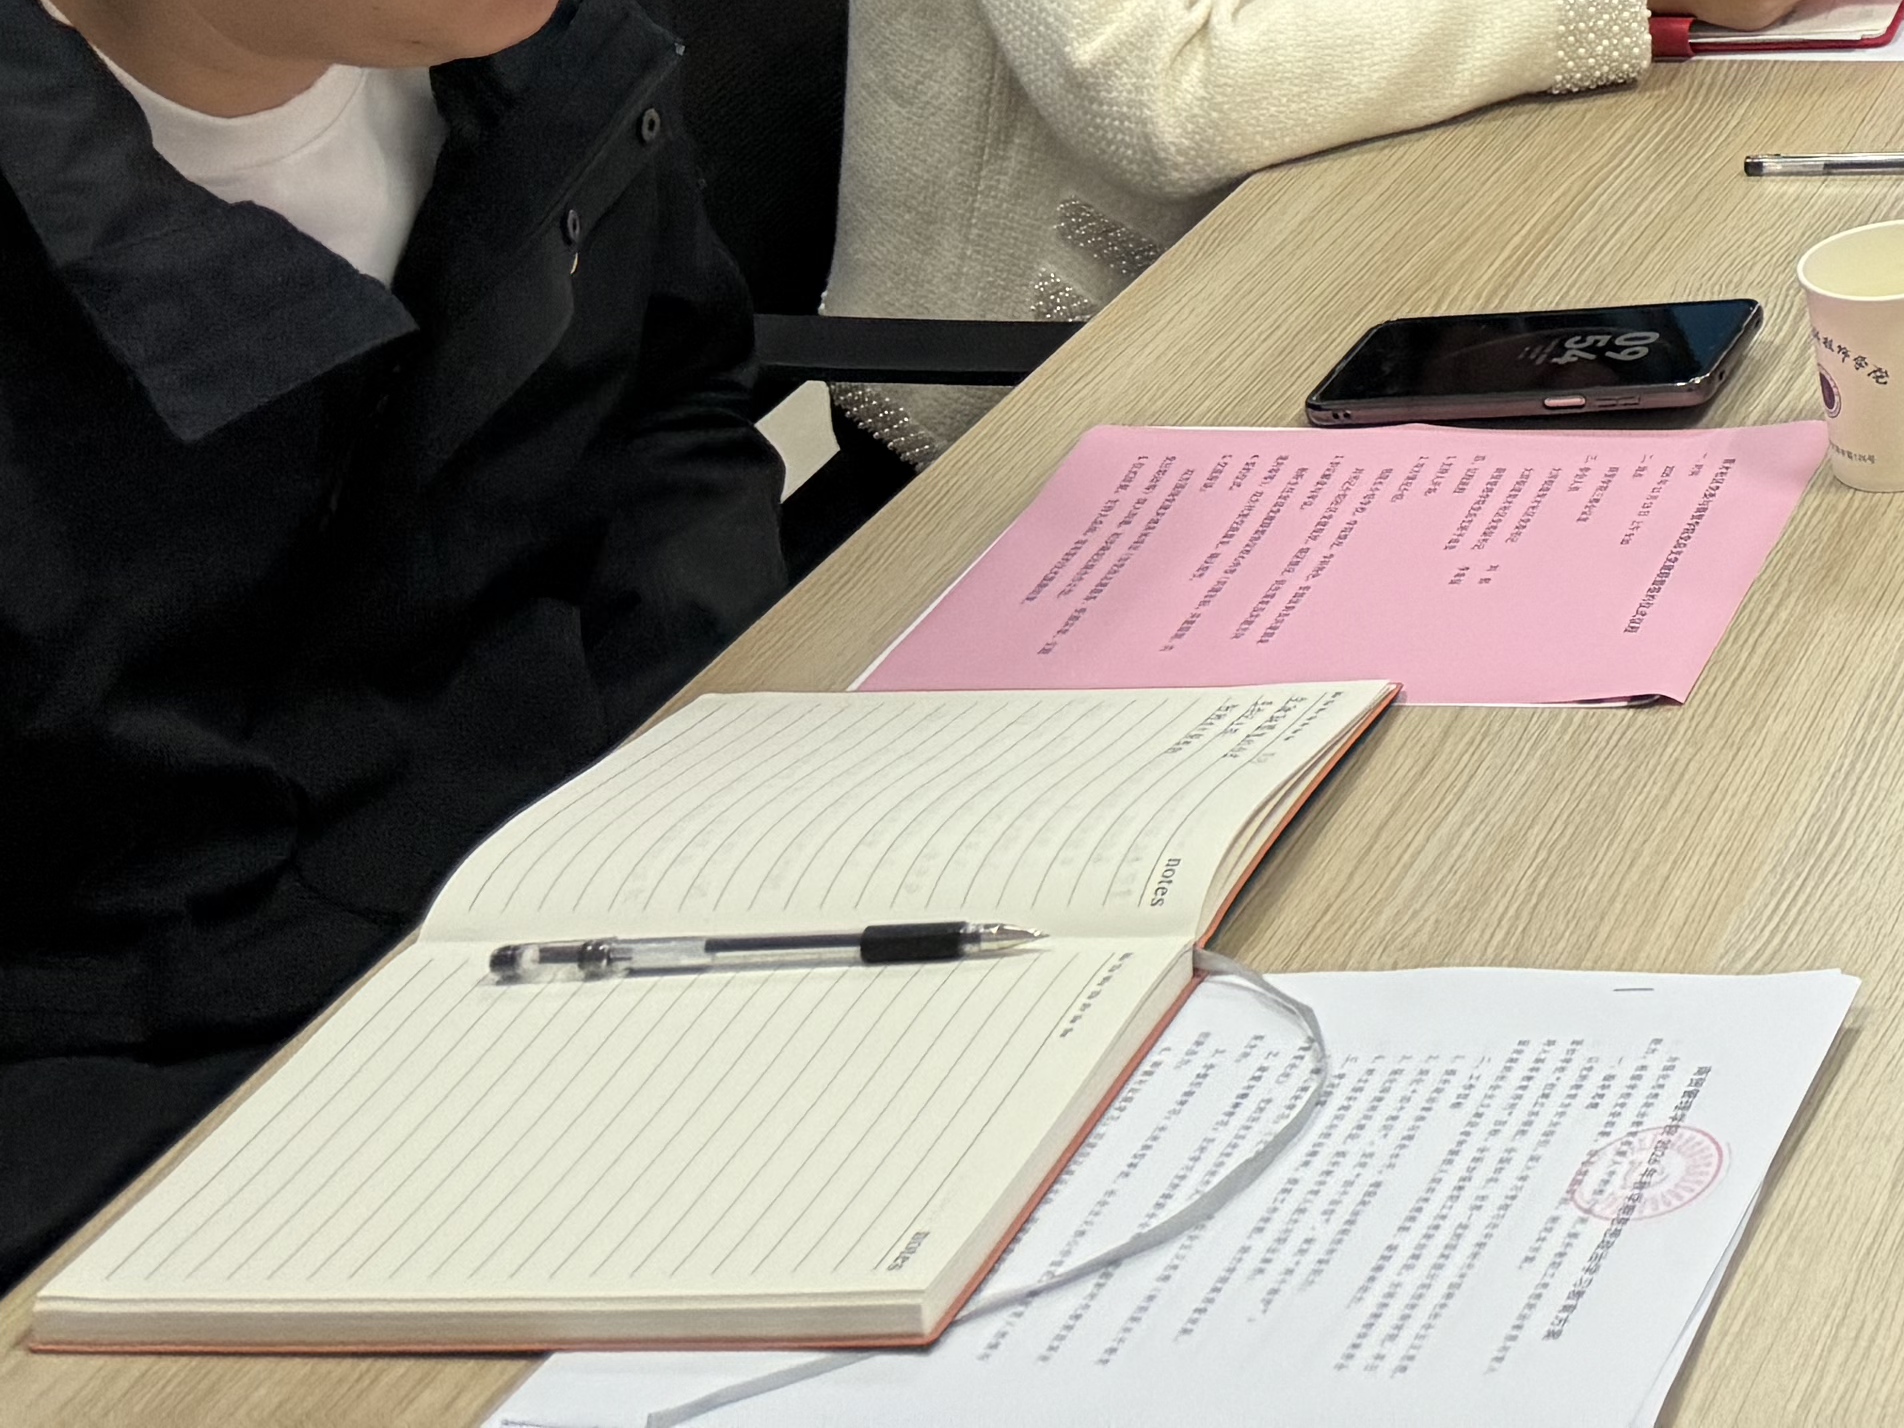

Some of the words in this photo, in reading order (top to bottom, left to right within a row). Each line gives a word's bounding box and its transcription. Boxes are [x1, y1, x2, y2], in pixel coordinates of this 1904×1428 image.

[1553, 334, 1604, 364] 54
[1605, 330, 1660, 362] 09
[1150, 857, 1182, 908] notes
